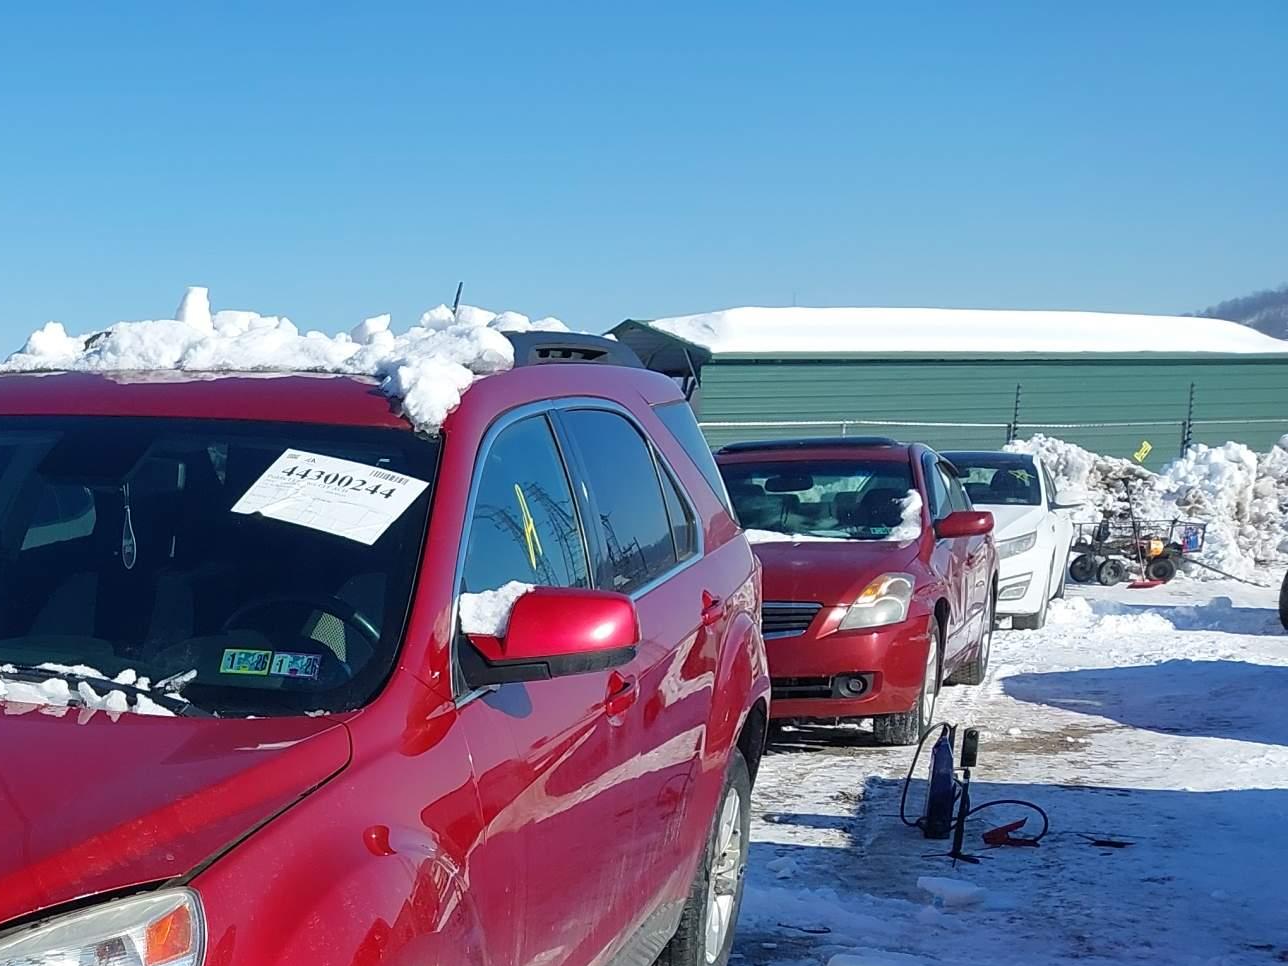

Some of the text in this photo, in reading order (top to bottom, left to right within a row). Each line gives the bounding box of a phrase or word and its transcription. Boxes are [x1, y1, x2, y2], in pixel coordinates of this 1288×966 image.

[281, 465, 397, 499] 44300244
[228, 653, 236, 669] 1
[276, 658, 284, 673] 1
